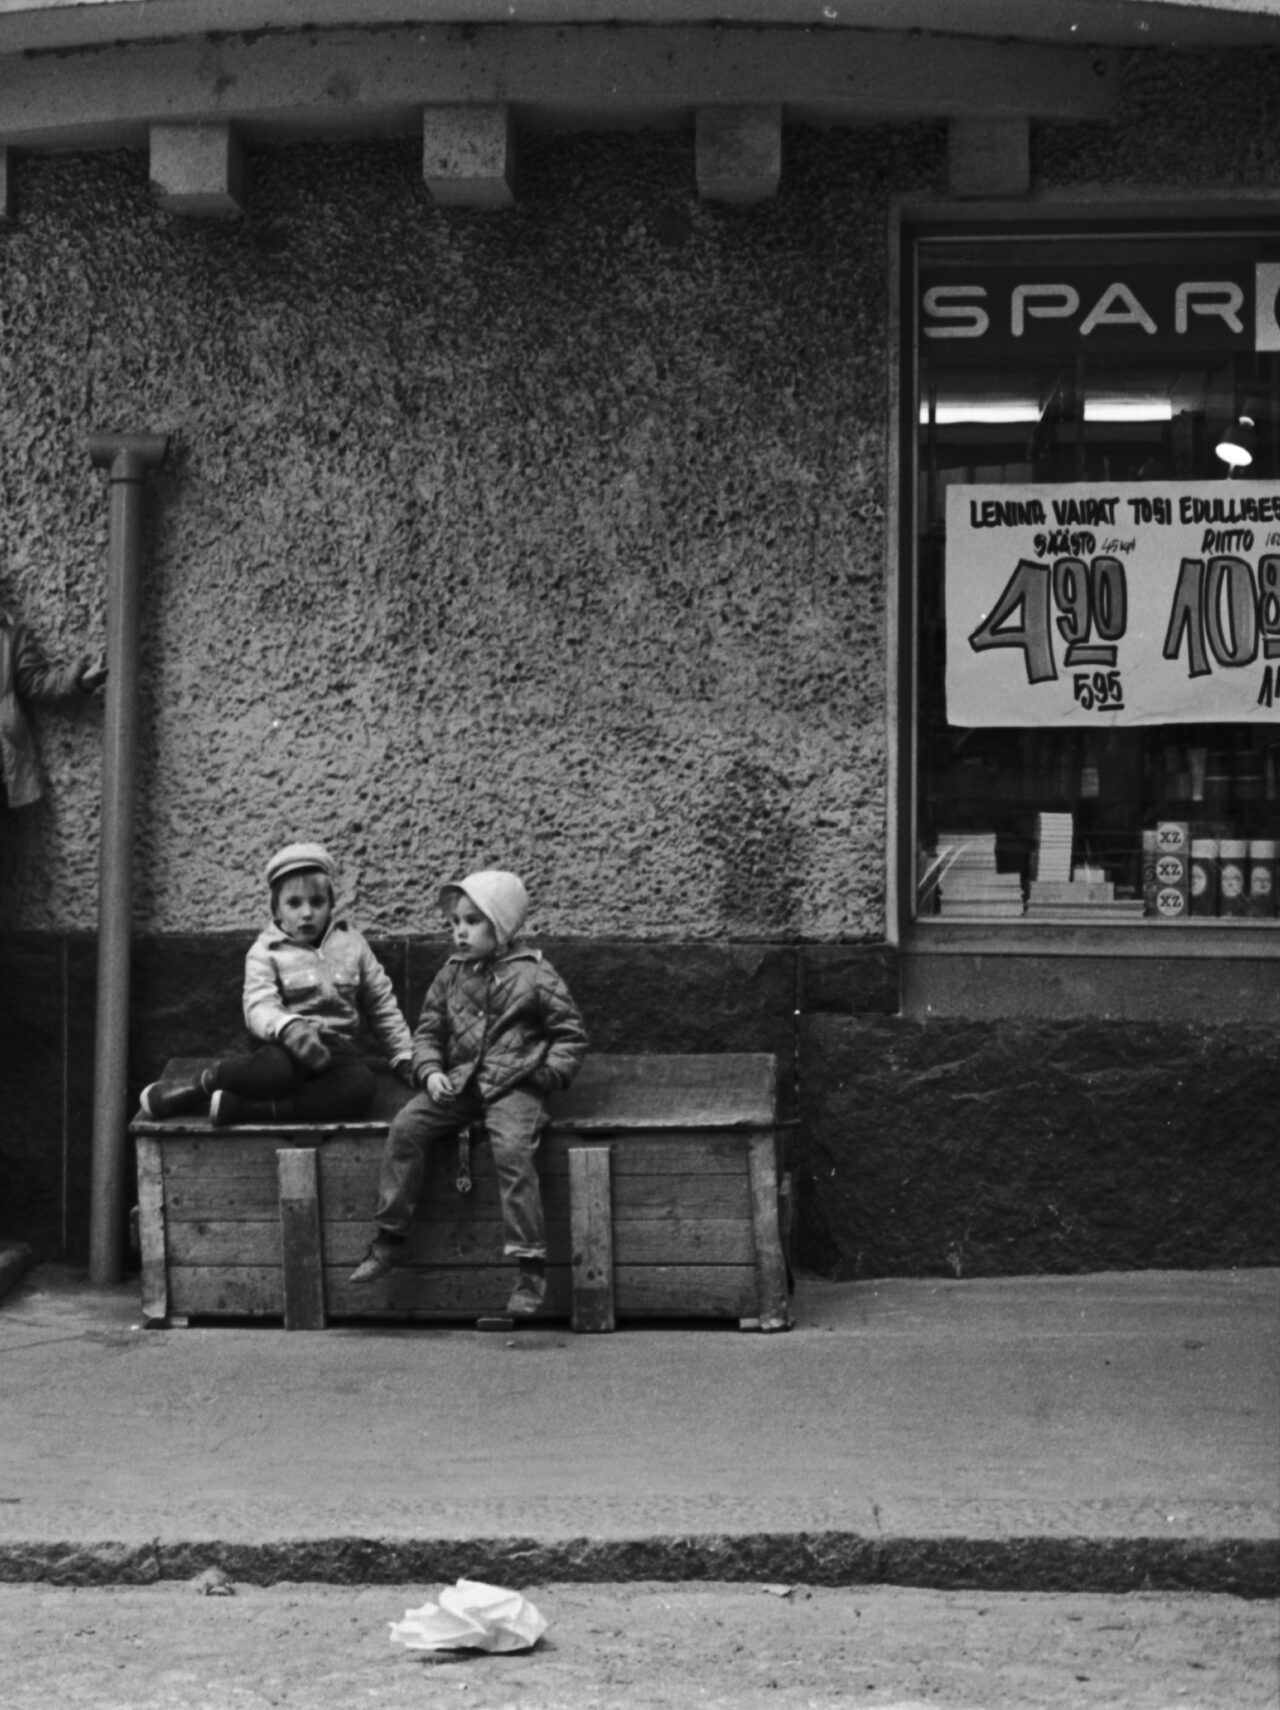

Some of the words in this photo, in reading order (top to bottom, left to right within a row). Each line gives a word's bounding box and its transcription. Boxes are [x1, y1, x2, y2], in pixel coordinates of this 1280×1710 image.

[923, 281, 1244, 337] SPAR
[1052, 497, 1120, 527] VAIPAT
[1127, 497, 1172, 525] TOSI
[1073, 671, 1123, 711] 595
[1160, 831, 1181, 844] XZ
[1159, 863, 1180, 876] XZ
[1160, 895, 1181, 908] XZ
